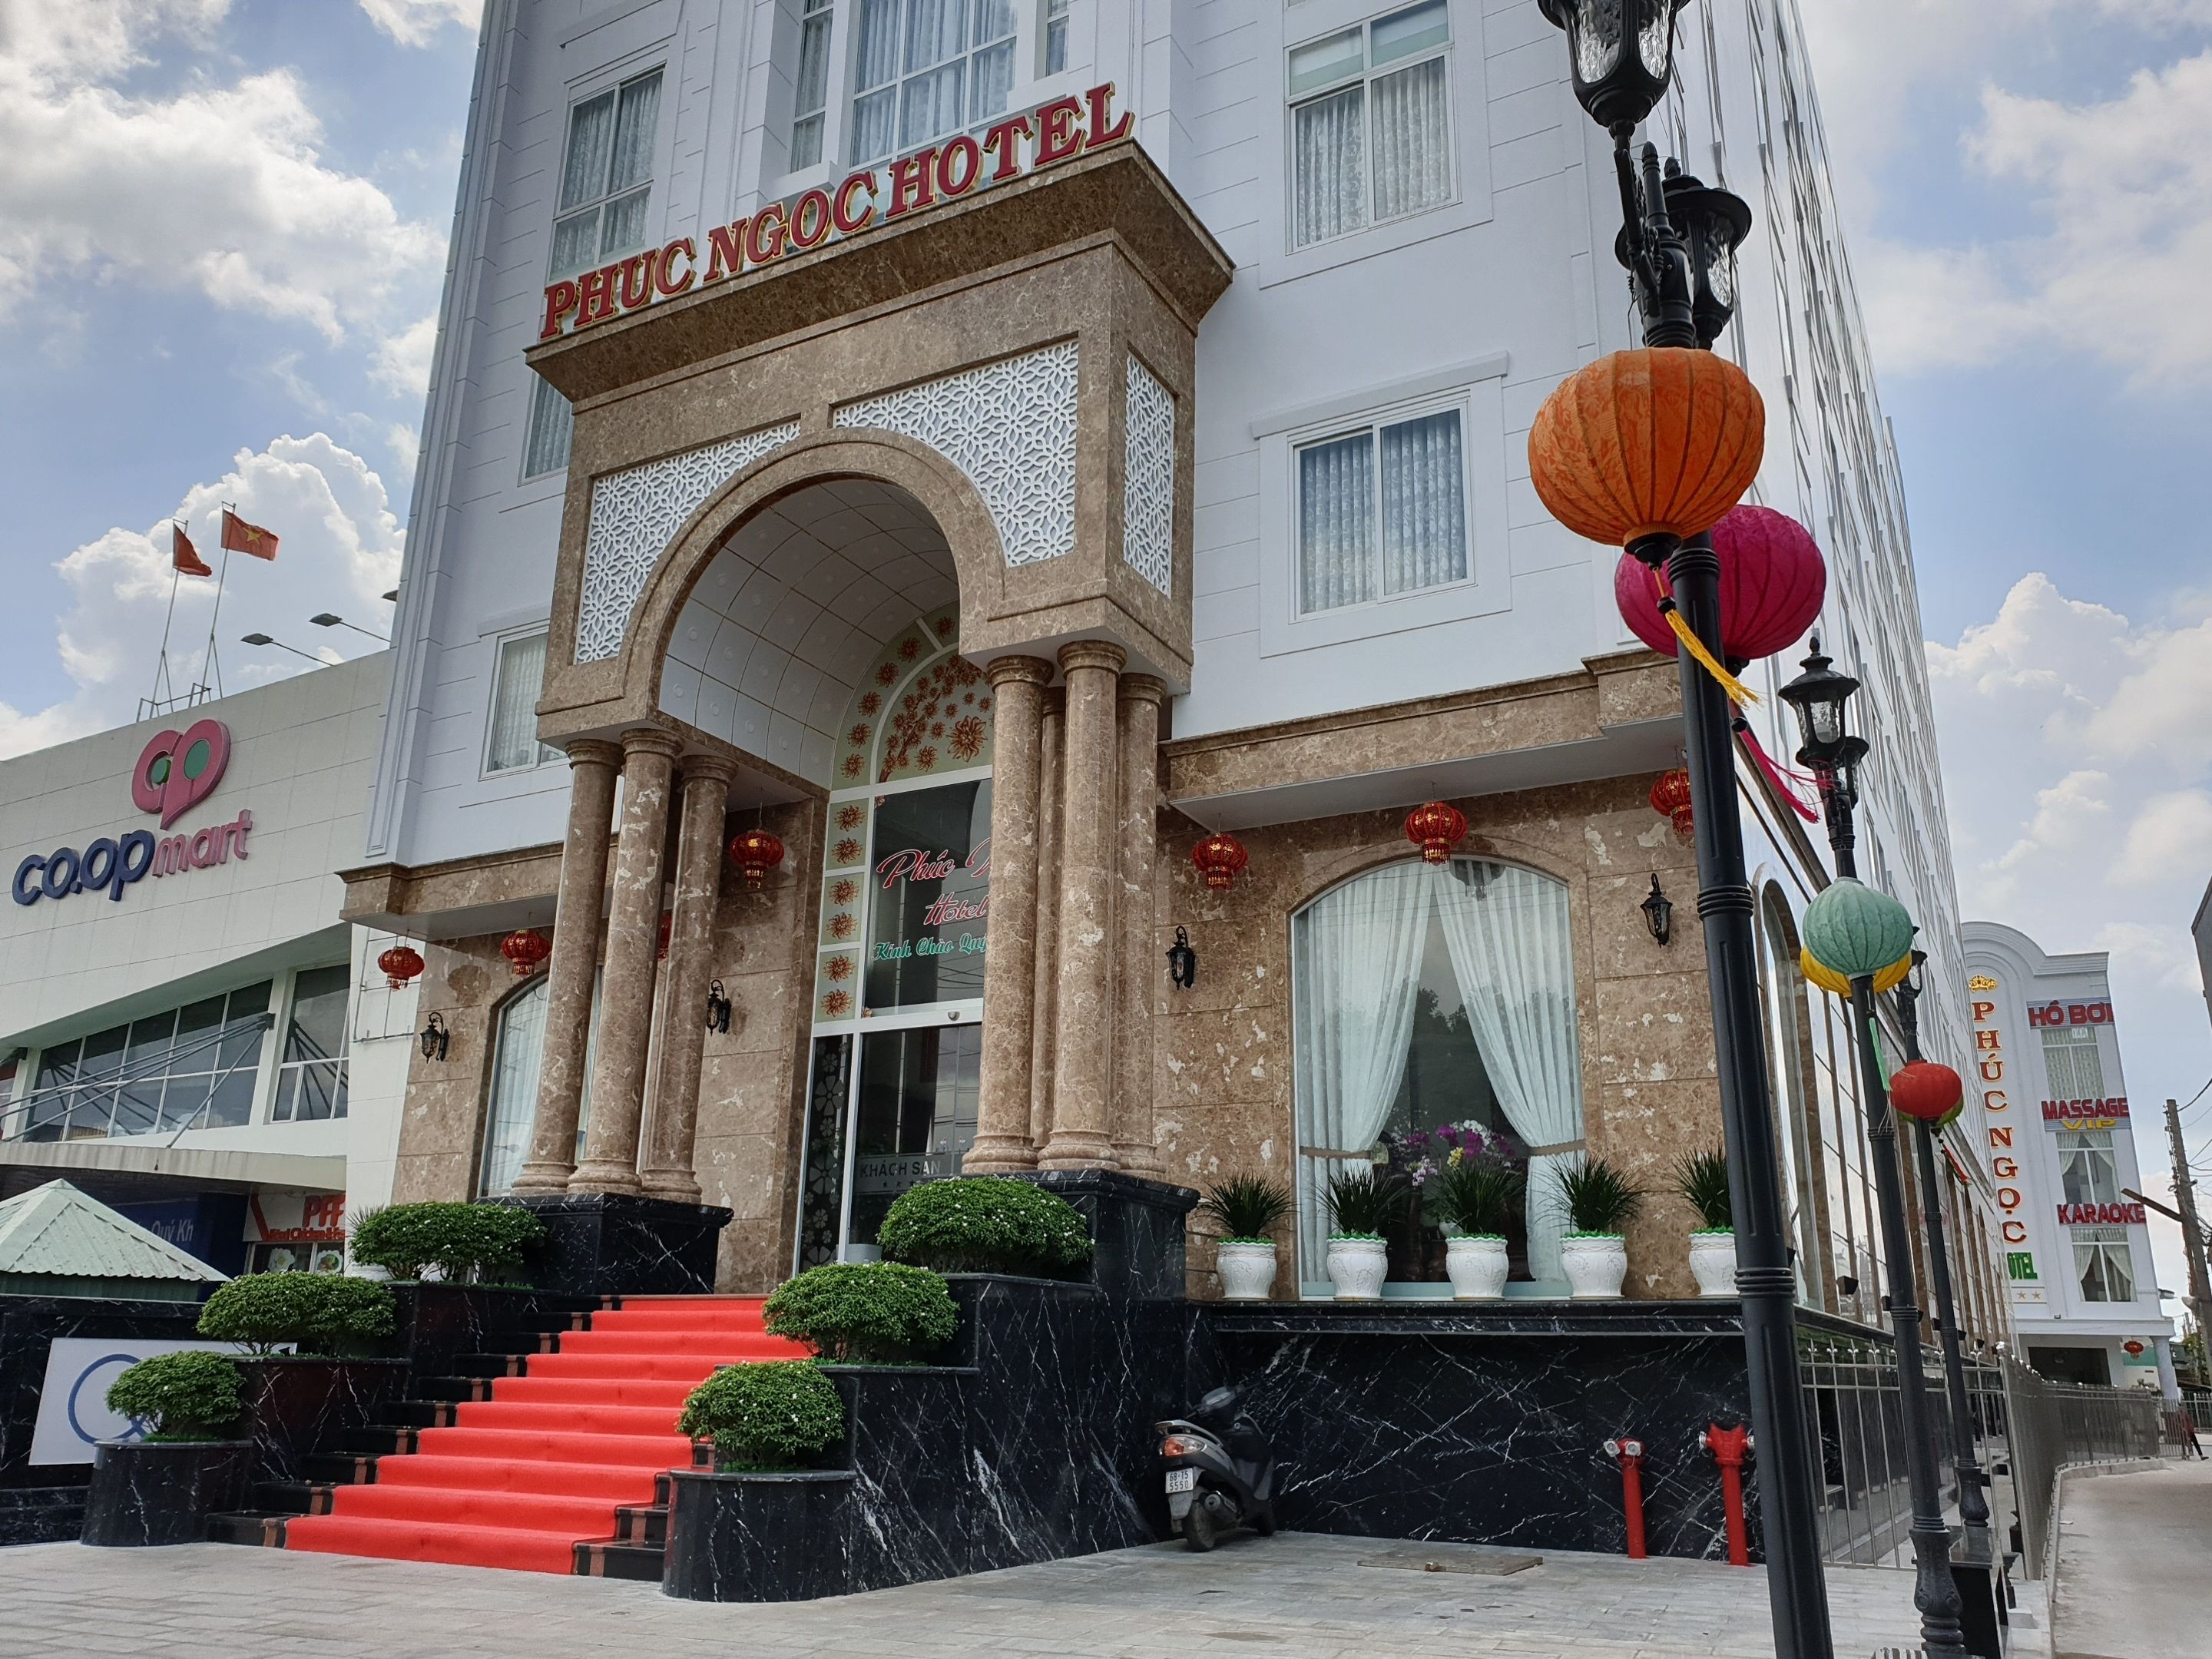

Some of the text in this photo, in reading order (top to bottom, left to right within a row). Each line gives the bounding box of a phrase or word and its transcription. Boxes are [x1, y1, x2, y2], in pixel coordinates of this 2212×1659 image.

[541, 81, 1135, 339] PHUC NGOC HOTEL
[876, 849, 955, 889] Phúc
[923, 892, 988, 926] Hotel
[1971, 1002, 2028, 1244] PHÚC NGỌC
[2041, 1098, 2130, 1120] MASSAGE
[2061, 1118, 2117, 1131] VIP
[2057, 1203, 2147, 1224] KARAOKE
[2006, 1252, 2038, 1280] OTEL
[1169, 1480, 1189, 1491] 5550
